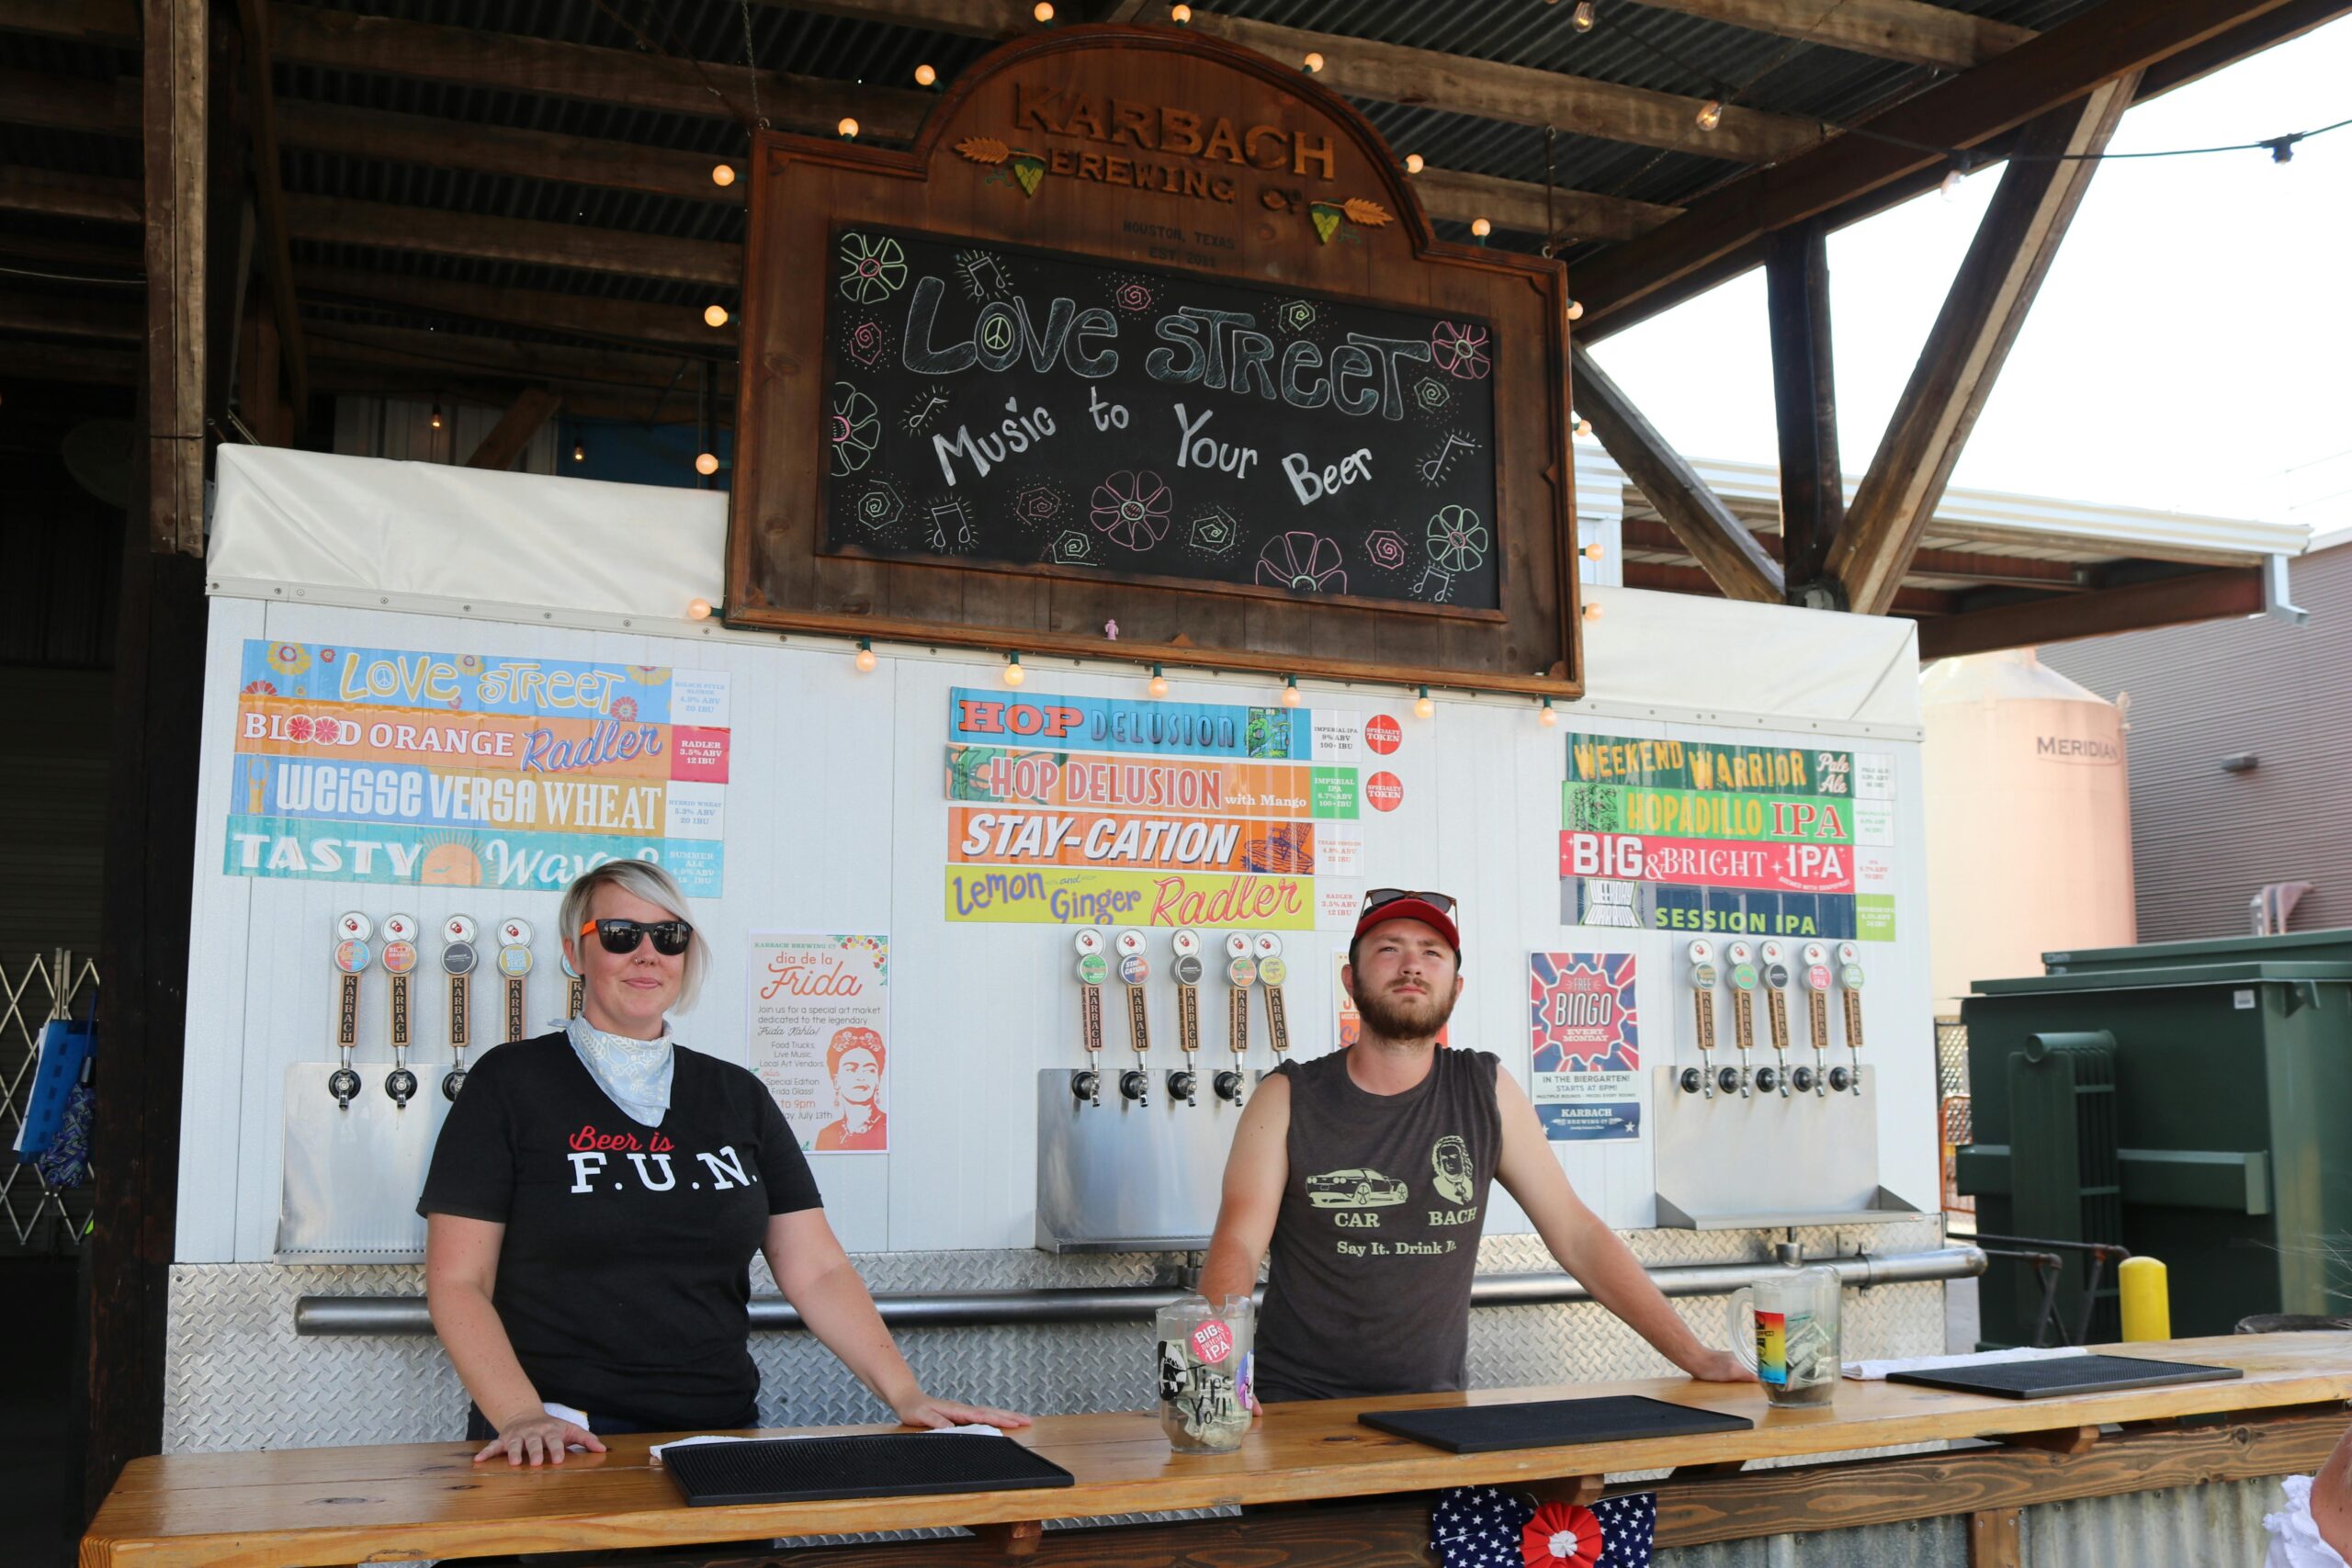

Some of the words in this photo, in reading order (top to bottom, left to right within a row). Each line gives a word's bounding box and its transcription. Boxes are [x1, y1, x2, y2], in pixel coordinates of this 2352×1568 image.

[1013, 81, 1335, 182] KARBACH
[1049, 147, 1237, 204] BREWING
[1123, 220, 1186, 243] HOUSTON,
[1194, 231, 1236, 250] TEXAS
[931, 395, 1057, 487] Music
[1088, 386, 1130, 432] to
[1174, 401, 1259, 479] Your
[1282, 448, 1373, 506] Beer
[243, 712, 362, 747] BLOOD
[368, 729, 514, 758] ORANGE
[520, 720, 664, 773] Radler
[958, 699, 1085, 739] HOP
[1091, 708, 1236, 749] DELUSION
[1368, 733, 1399, 742] TOKEN
[682, 740, 721, 749] RADLER
[1816, 752, 1850, 773] Pale
[2037, 737, 2118, 758] MERIDIAN
[989, 757, 1059, 799] HOP
[1066, 761, 1222, 809] DELUSION
[1224, 794, 1259, 807] with
[1261, 794, 1307, 809] Mango
[1315, 777, 1355, 785] IMPERIAL
[1574, 740, 1684, 781] WEEKEND
[1688, 750, 1807, 791] WARRIOR
[1819, 773, 1848, 795] Ale
[542, 781, 662, 831] WHEAT
[1369, 790, 1401, 798] TOKEN
[1626, 792, 1763, 835] HOPADILLO
[1770, 801, 1847, 840] IPA
[670, 851, 713, 860] SUMMER
[962, 813, 1239, 864] STAY-CATION
[1572, 832, 1644, 877] BIG
[1645, 853, 1666, 880] &
[1664, 846, 1768, 878] BRIGHT
[1788, 844, 1845, 879] IPA
[232, 832, 424, 877] TASTY
[485, 838, 660, 886] Wav
[952, 872, 1046, 917] Lemon
[1059, 874, 1080, 886] and
[1050, 887, 1142, 925] Ginger
[1149, 874, 1303, 927] Radler
[1655, 907, 1766, 934] SESSION
[1776, 912, 1817, 936] IPA
[801, 952, 816, 964] de
[821, 953, 832, 964] la
[761, 961, 863, 999] Frida
[1574, 977, 1591, 991] FREE
[342, 976, 356, 1043] KARBACH
[395, 977, 406, 1043] KARBACH
[453, 978, 464, 1043] KARBACH
[510, 979, 521, 1042] KARBACH
[758, 1006, 772, 1014] Join
[808, 1007, 836, 1016] special
[758, 1016, 798, 1024] dedicated
[829, 1017, 868, 1026] legendary
[1090, 987, 1102, 1047] KARBACH
[1133, 987, 1148, 1048] KARBACH
[1186, 988, 1198, 1047] KARBACH
[1237, 989, 1247, 1049] KARBACH
[1271, 987, 1286, 1047] KARBACH
[1555, 993, 1613, 1027] BINGO
[757, 1026, 785, 1036] Frida
[765, 1078, 792, 1087] Special
[781, 1100, 791, 1108] to
[794, 1100, 816, 1110] 9pm
[798, 1111, 813, 1120] July
[1561, 1109, 1612, 1117] KARBACH
[569, 1125, 643, 1151] Beer
[649, 1131, 674, 1152] is
[567, 1145, 758, 1194] F.U.N.
[1334, 1213, 1380, 1228] CAR
[1428, 1207, 1477, 1226] BACH
[1337, 1241, 1366, 1258] Say
[1371, 1242, 1390, 1255] It.
[1395, 1241, 1442, 1255] Drink
[1194, 1324, 1217, 1344] BIG
[1205, 1340, 1230, 1361] IPA
[1186, 1363, 1231, 1404] Tips
